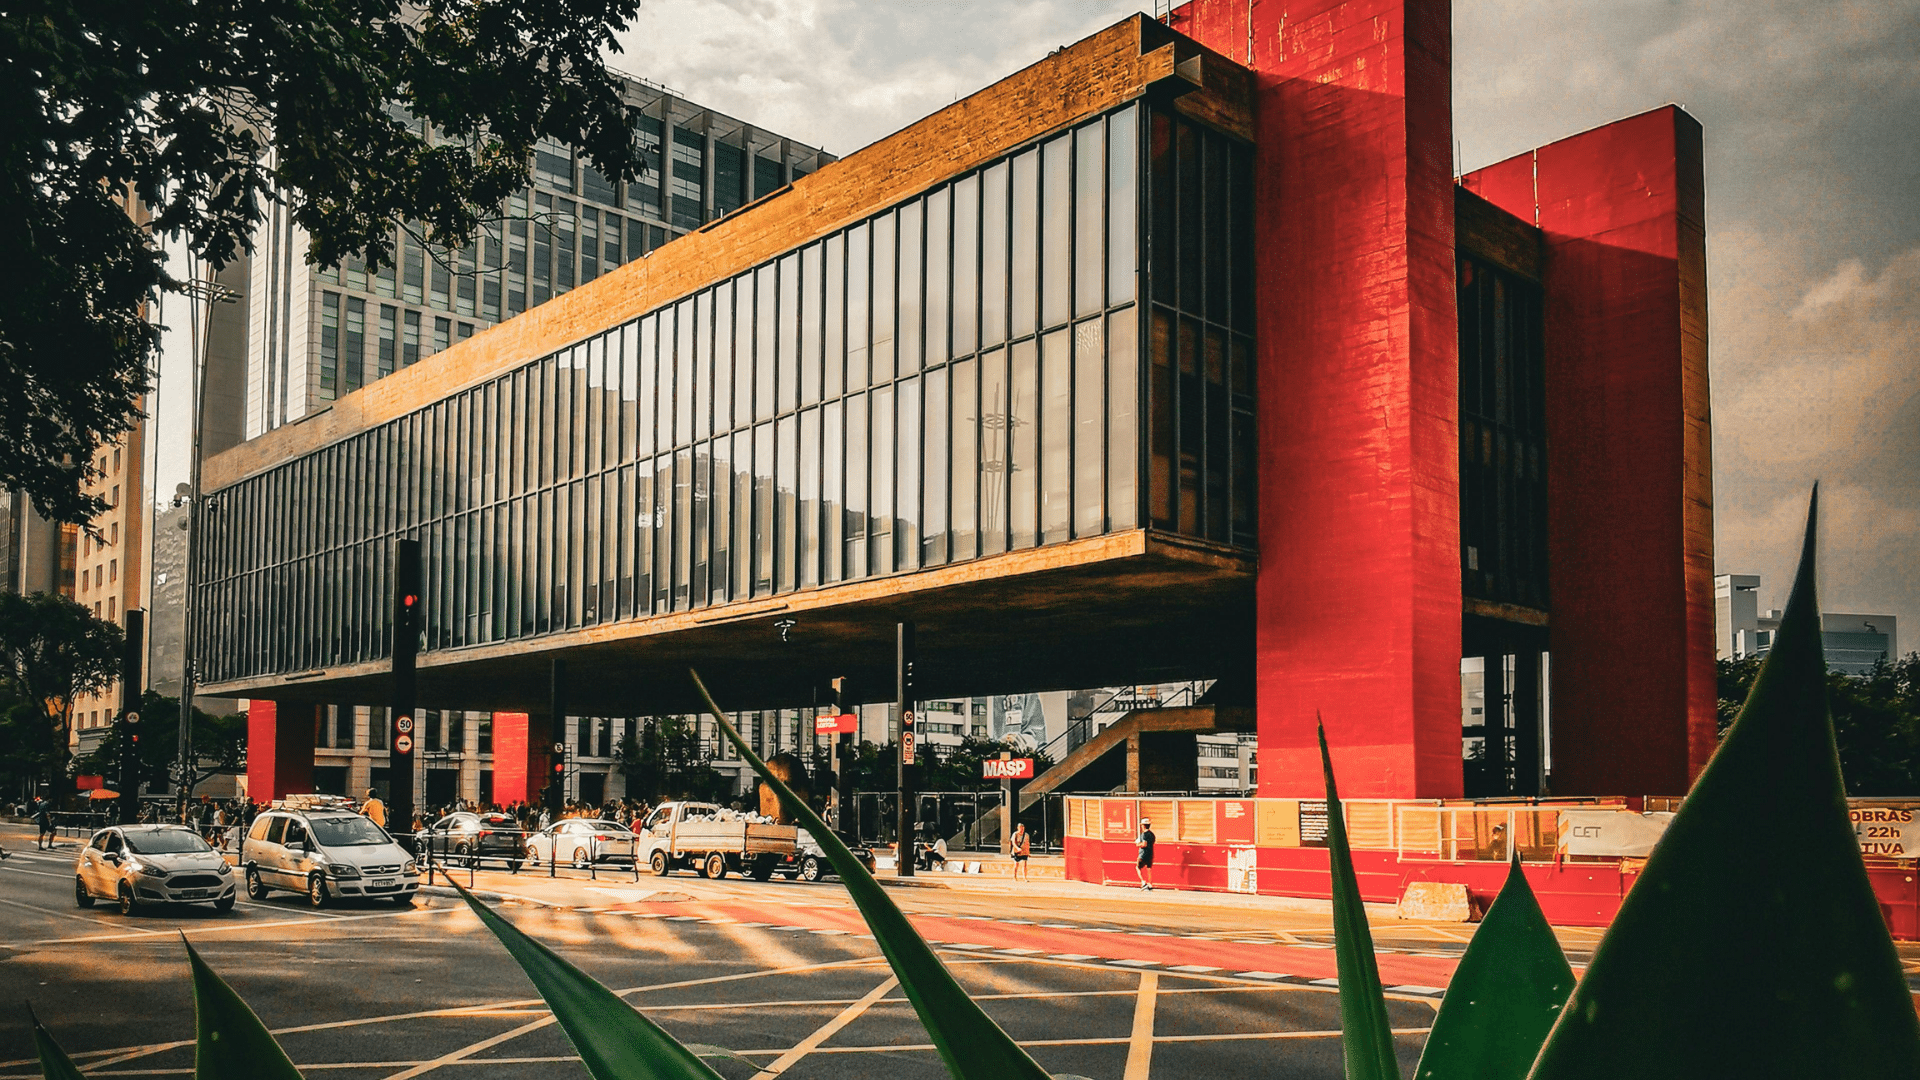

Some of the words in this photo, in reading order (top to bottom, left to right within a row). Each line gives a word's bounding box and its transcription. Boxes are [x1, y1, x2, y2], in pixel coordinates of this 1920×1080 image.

[400, 720, 411, 728] 50
[983, 760, 1026, 776] MASP
[1850, 810, 1912, 822] OBRAS
[1573, 826, 1601, 838] CET
[1868, 826, 1900, 838] 22h
